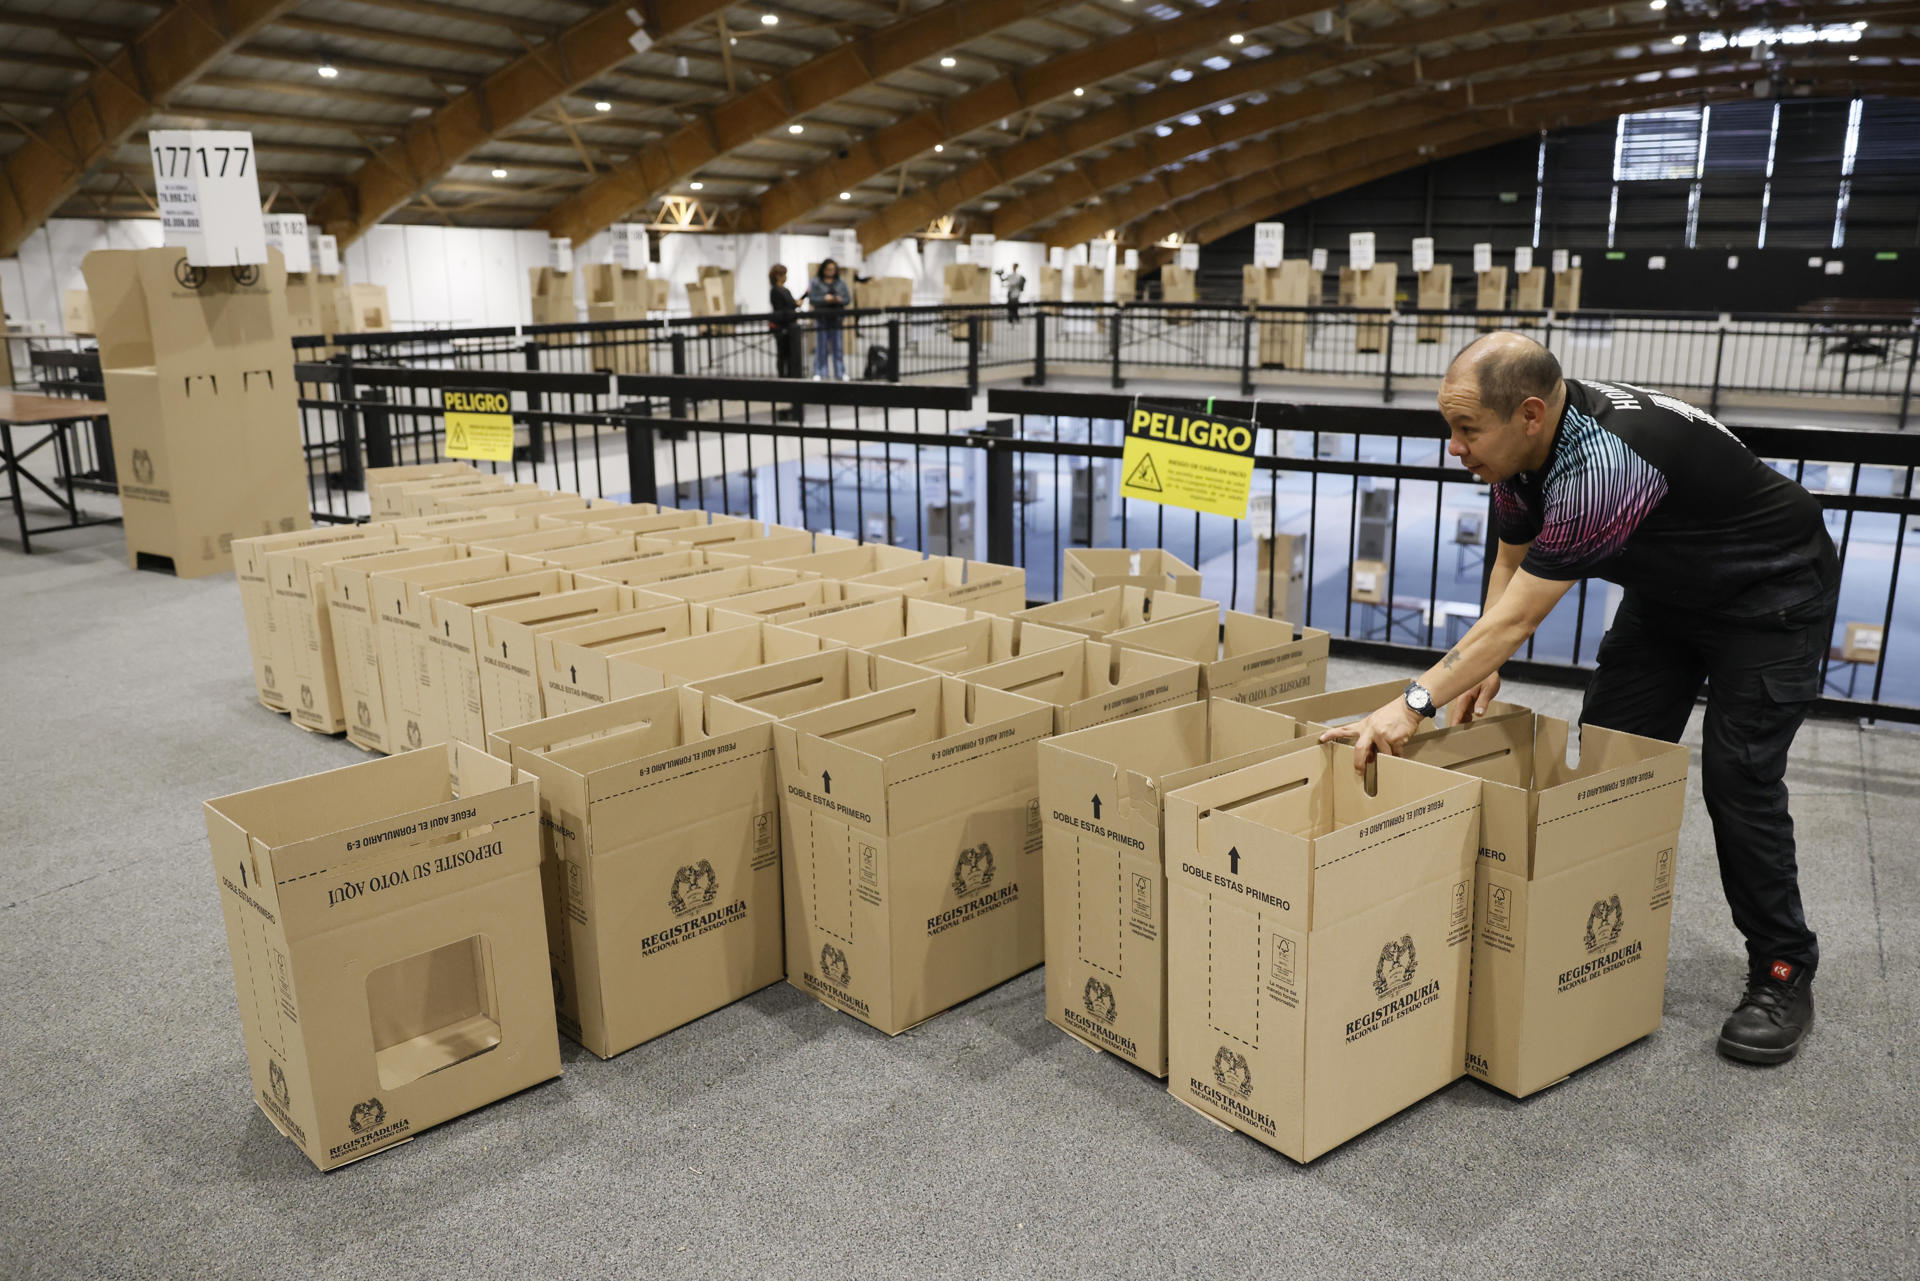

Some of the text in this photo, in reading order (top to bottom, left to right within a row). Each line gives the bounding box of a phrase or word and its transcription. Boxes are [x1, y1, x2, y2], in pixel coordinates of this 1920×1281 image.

[154, 147, 191, 177] 177
[196, 147, 249, 177] 177
[444, 392, 508, 412] PELIGRO
[1132, 409, 1252, 452] PELIGRO
[788, 785, 871, 823] DOBLE ESTAS PRIMERO
[346, 808, 476, 851] PEGUE AQUÍ EL FORMULARIO E-9
[1053, 810, 1144, 850] DOBLE ESTAS PRIMERO
[328, 841, 502, 908] DEPOSITE SU VOTO AQUÍ
[1478, 848, 1506, 862] MERO
[927, 881, 1018, 930] REGISTRADURÍA
[1182, 863, 1290, 911] DOBLE ESTAS PRIMERO
[641, 899, 747, 950] REGISTRADURÍA
[642, 912, 747, 958] NACIONAL DEL ESTADO CIVIL
[1558, 940, 1642, 986] REGISTRADURÍA
[1558, 953, 1642, 994] NACIONAL DEL ESTADO CIVIL
[804, 972, 870, 1013] REGISTRADURÍA
[1346, 978, 1440, 1036] REGISTRADURÍA
[1064, 1008, 1136, 1053] REGISTRADURÍA
[1346, 993, 1440, 1046] NACIONAL DEL ESTADO CIVIL
[1190, 1078, 1276, 1130] REGISTRADURÍA
[1190, 1087, 1277, 1138] NACIONAL DEL ESTADO CIVIL
[329, 1118, 410, 1156] REGISTRADURÍA
